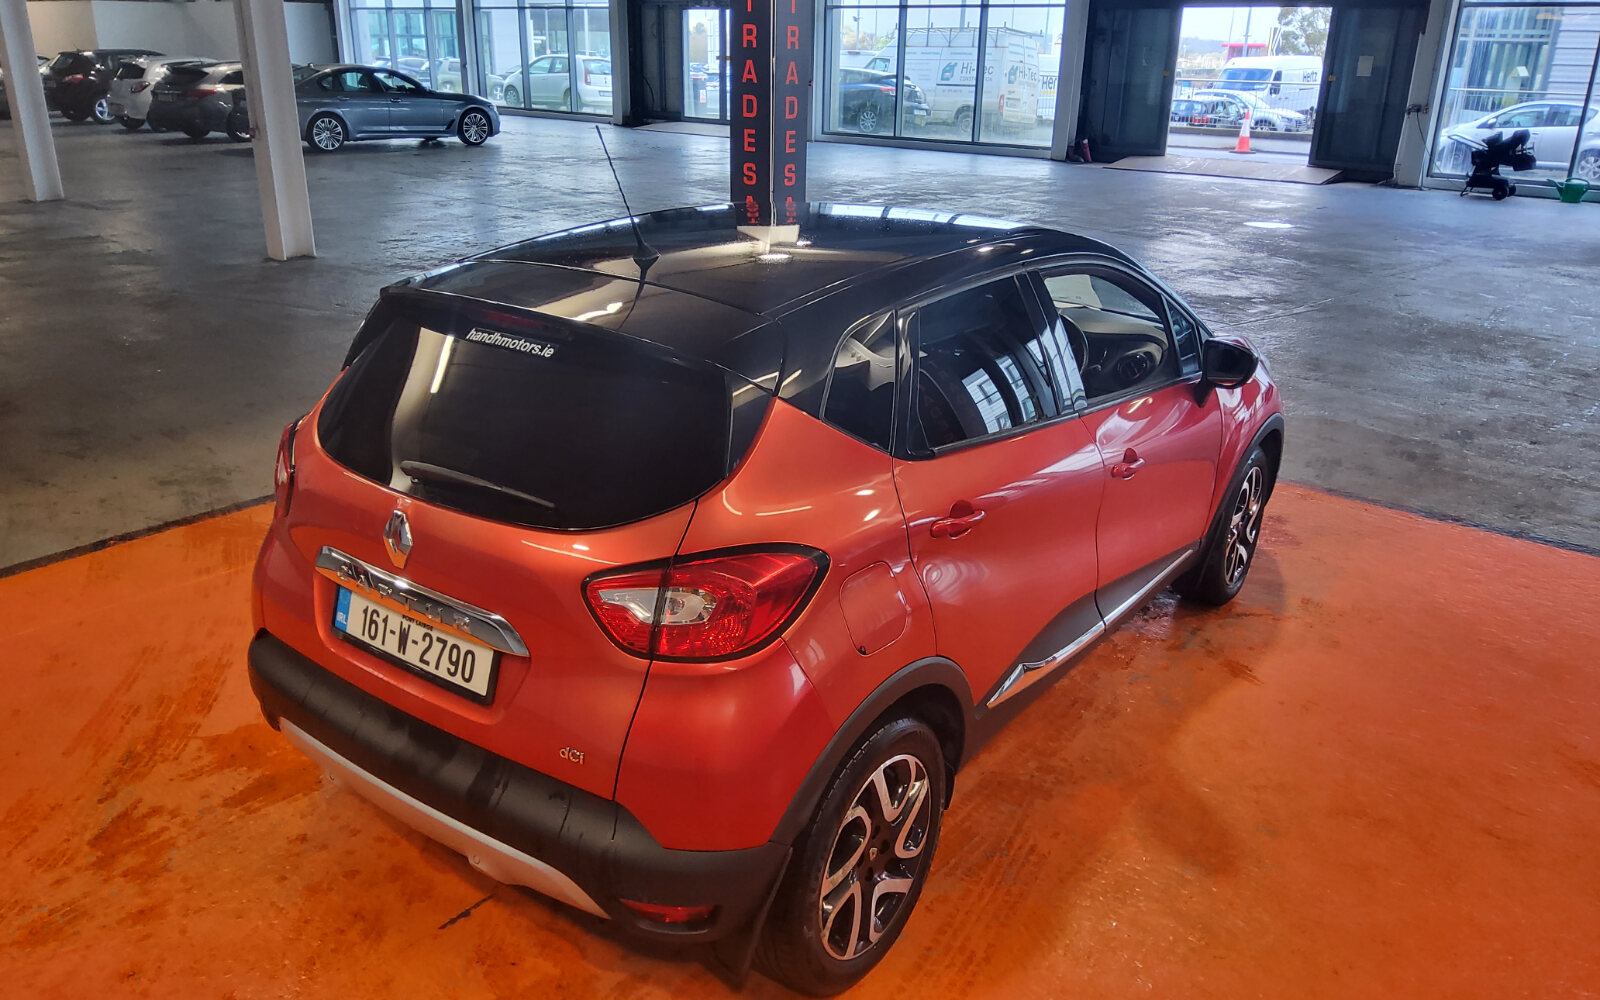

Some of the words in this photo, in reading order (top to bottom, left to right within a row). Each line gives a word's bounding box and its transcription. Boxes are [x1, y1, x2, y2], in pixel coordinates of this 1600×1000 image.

[960, 61, 994, 75] Hi-ec
[1041, 75, 1058, 90] Her
[466, 327, 555, 358] handhmotors.ie
[361, 605, 476, 684] 161-W-2790
[560, 747, 584, 765] dCi
